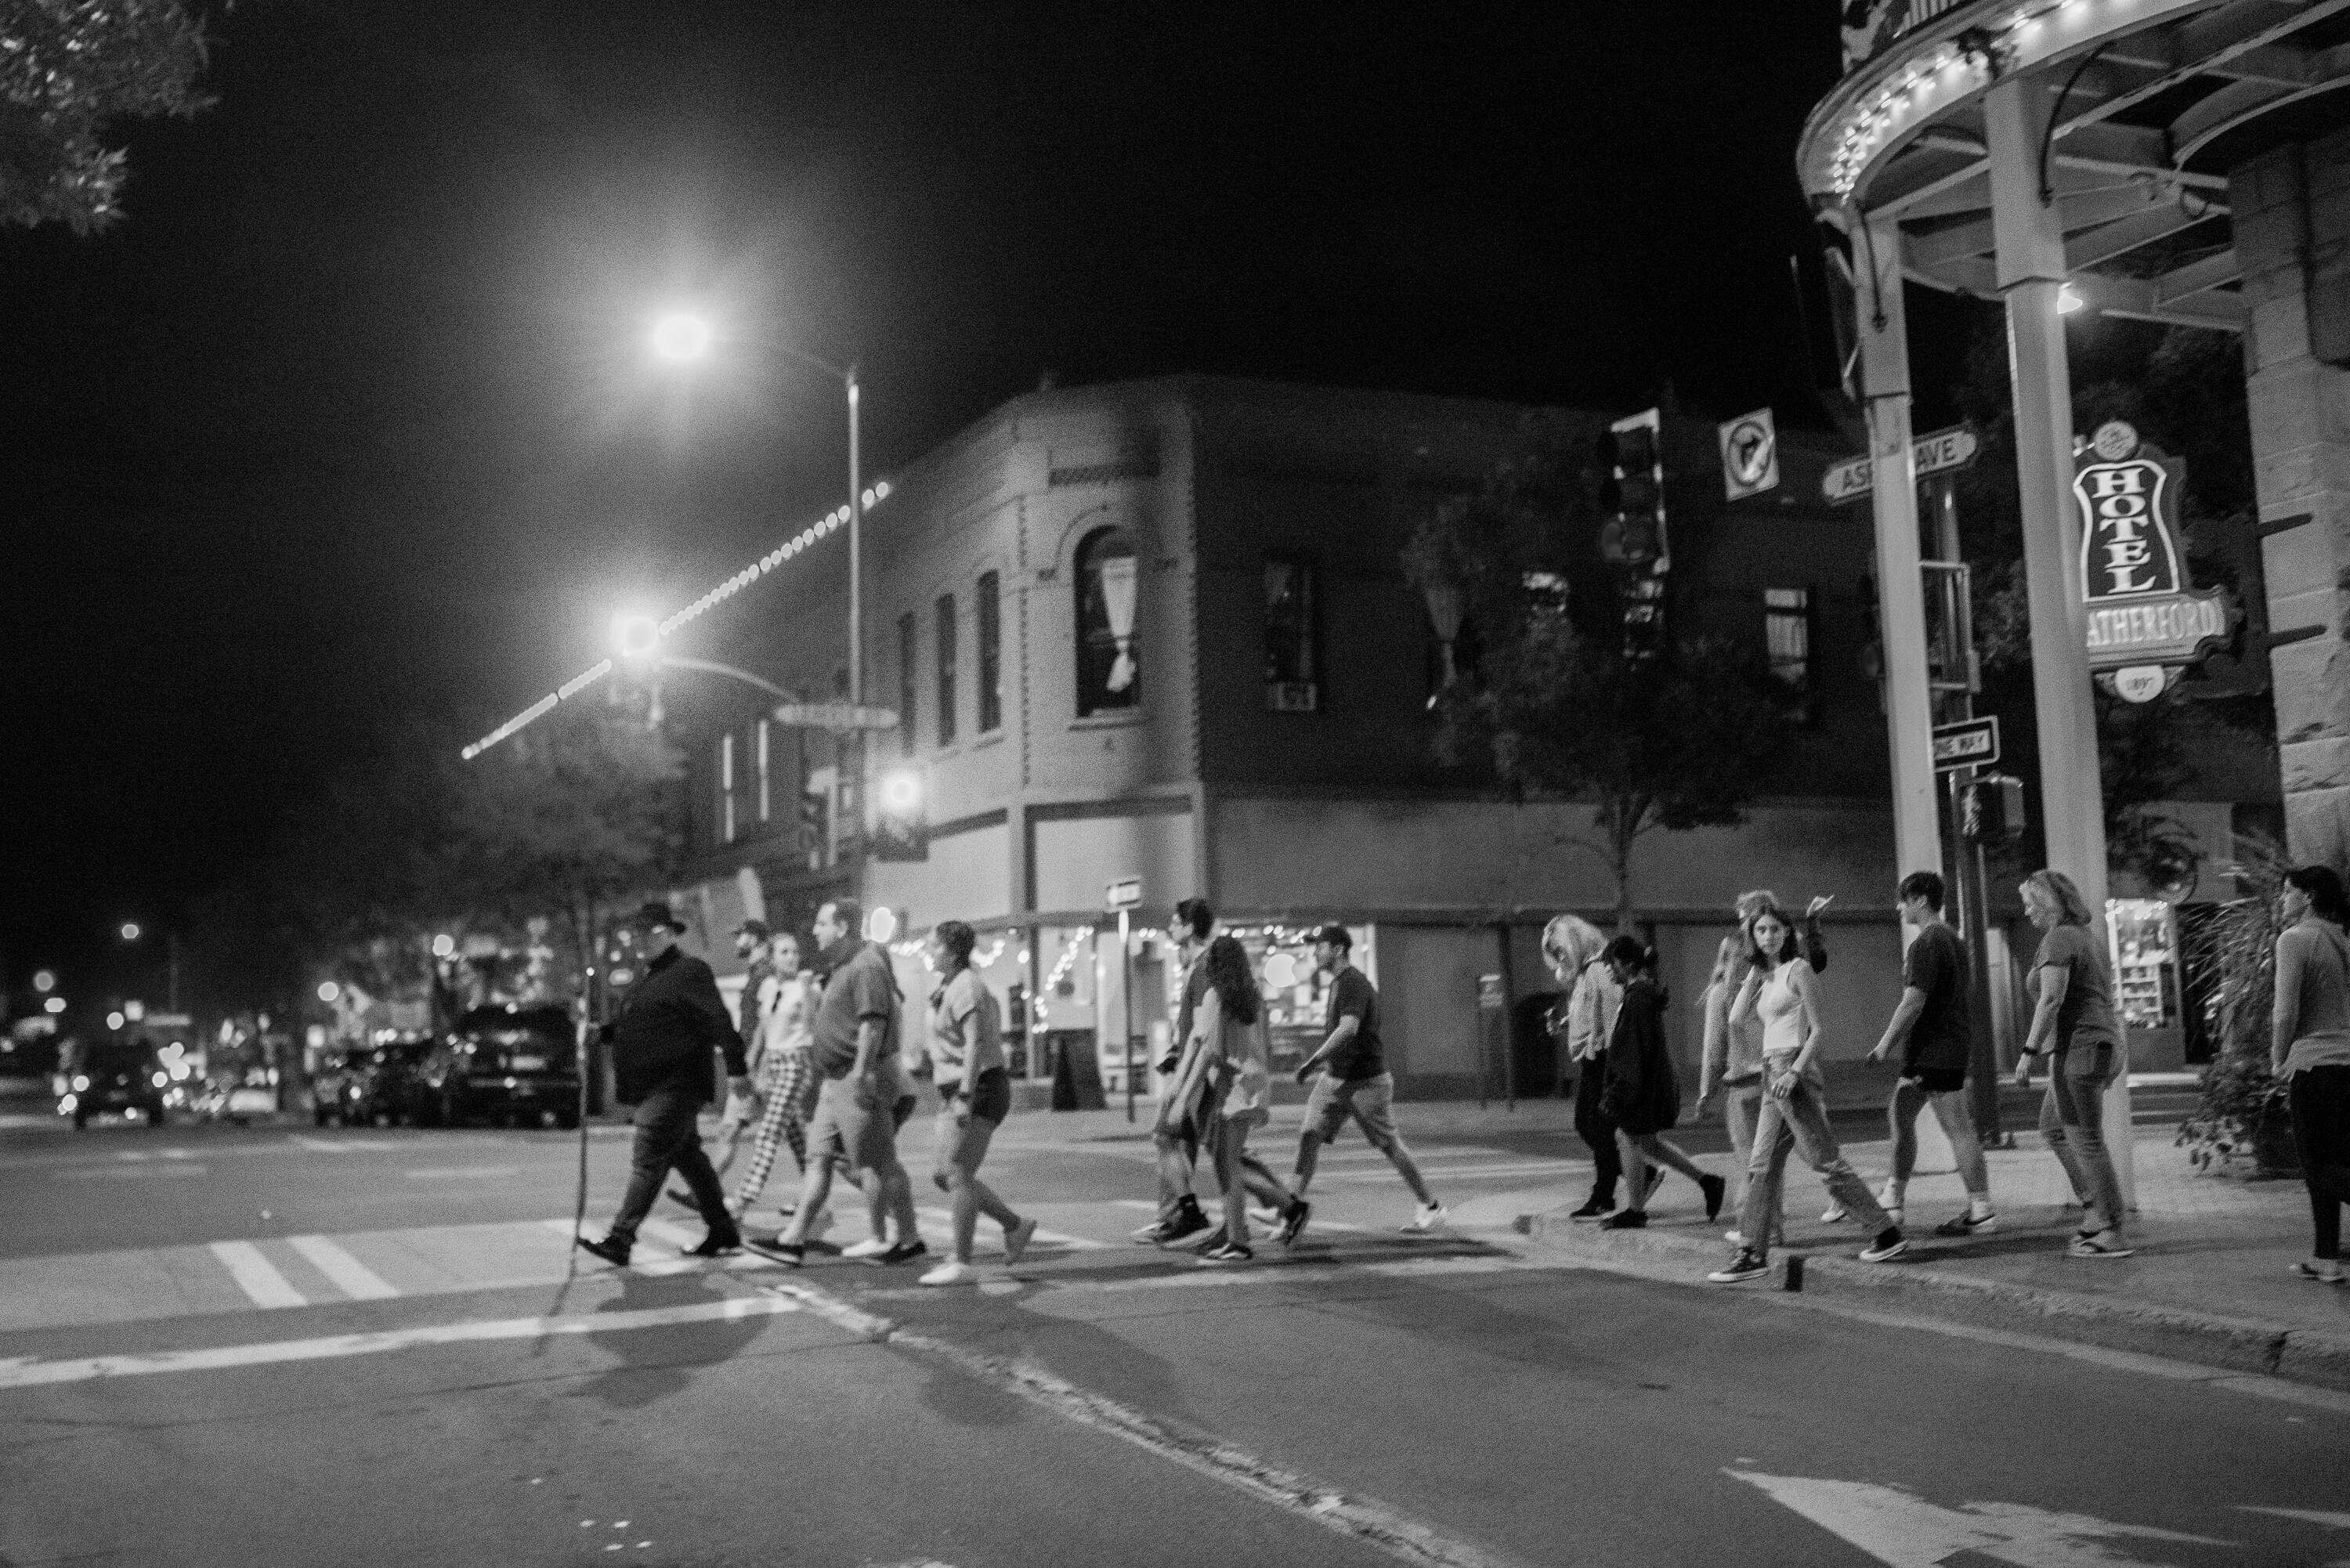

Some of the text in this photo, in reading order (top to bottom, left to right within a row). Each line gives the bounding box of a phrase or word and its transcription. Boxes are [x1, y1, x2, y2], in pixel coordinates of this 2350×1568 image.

[1842, 437, 1957, 491] AS AVE
[2092, 468, 2157, 594] HOTEL
[2086, 600, 2217, 648] ATHERFORD
